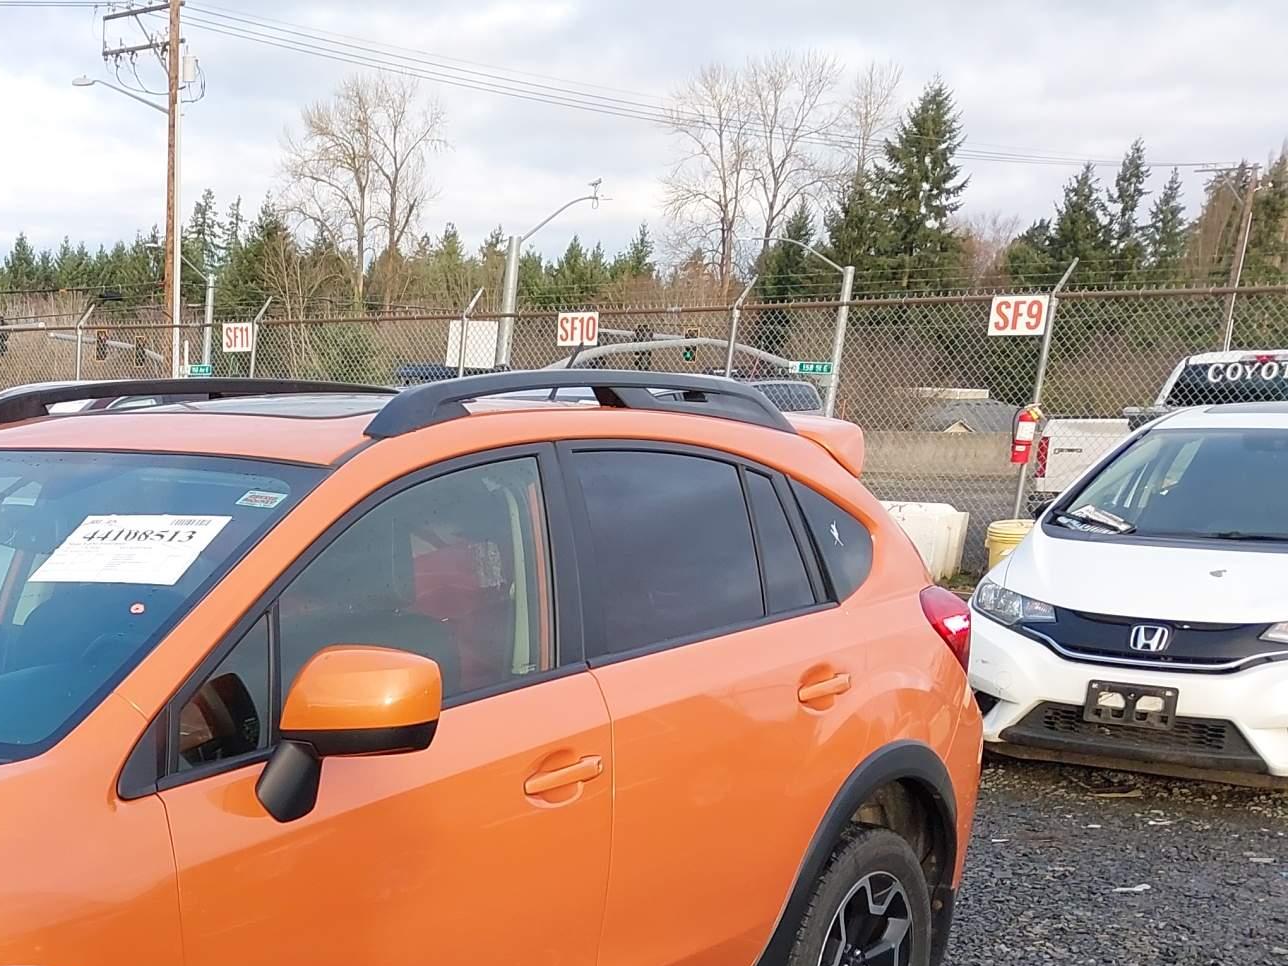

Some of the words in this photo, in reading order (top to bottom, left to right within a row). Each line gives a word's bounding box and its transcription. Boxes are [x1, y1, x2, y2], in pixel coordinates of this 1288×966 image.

[994, 300, 1043, 331] SF9
[225, 326, 249, 349] SF11
[559, 316, 596, 342] SF10
[82, 528, 197, 543] 44108513
